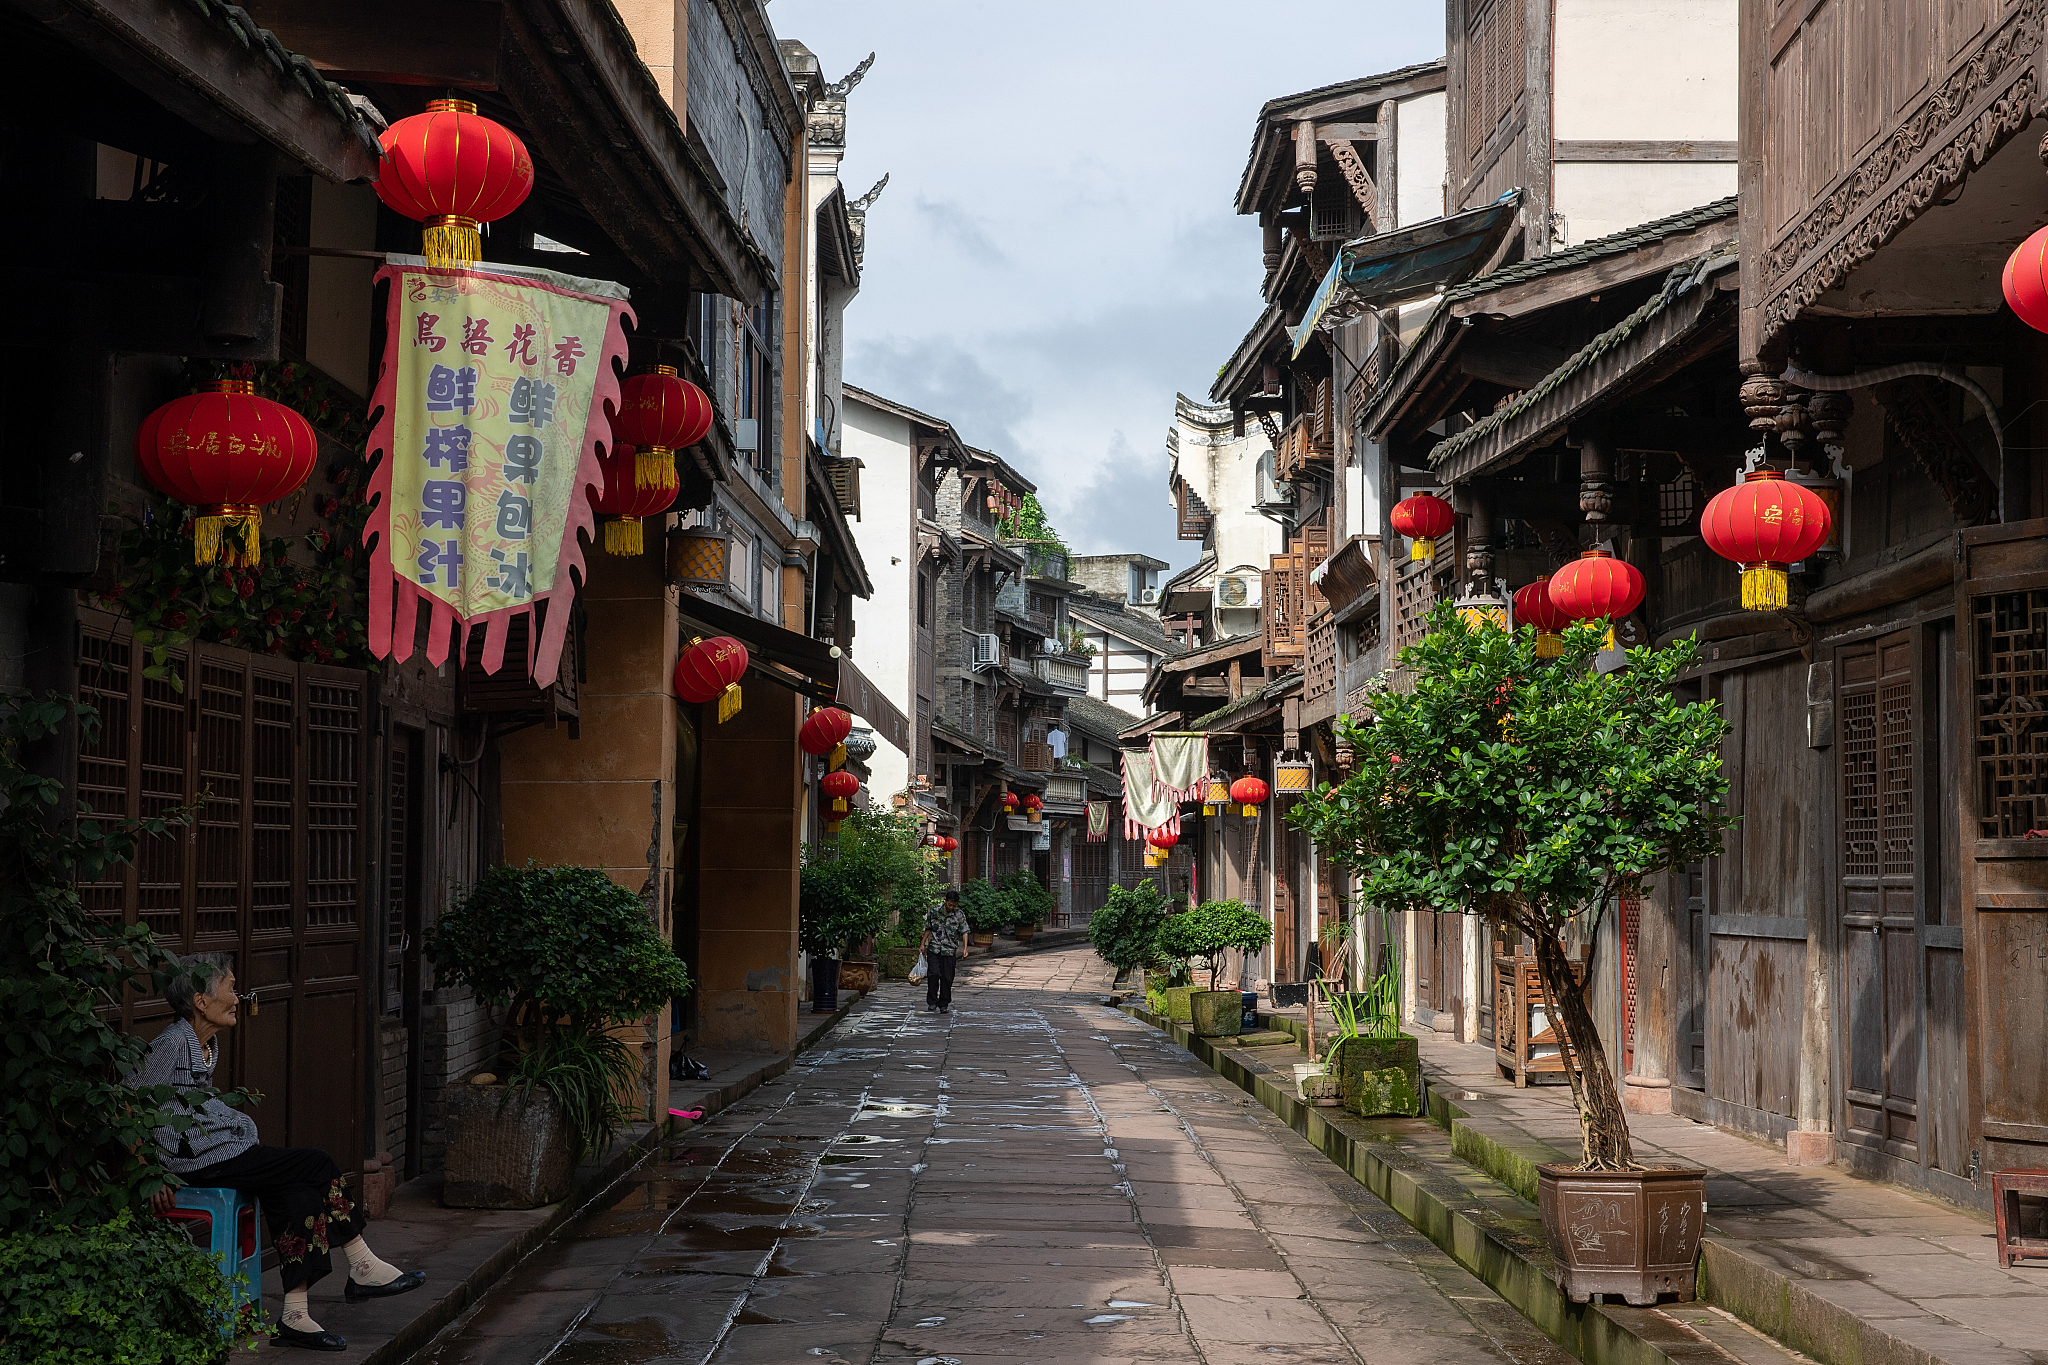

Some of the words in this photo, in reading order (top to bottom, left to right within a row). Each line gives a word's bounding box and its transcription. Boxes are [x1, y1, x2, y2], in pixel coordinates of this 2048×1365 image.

[428, 287, 459, 305] 安居
[418, 363, 478, 589] 鲜榨果汁
